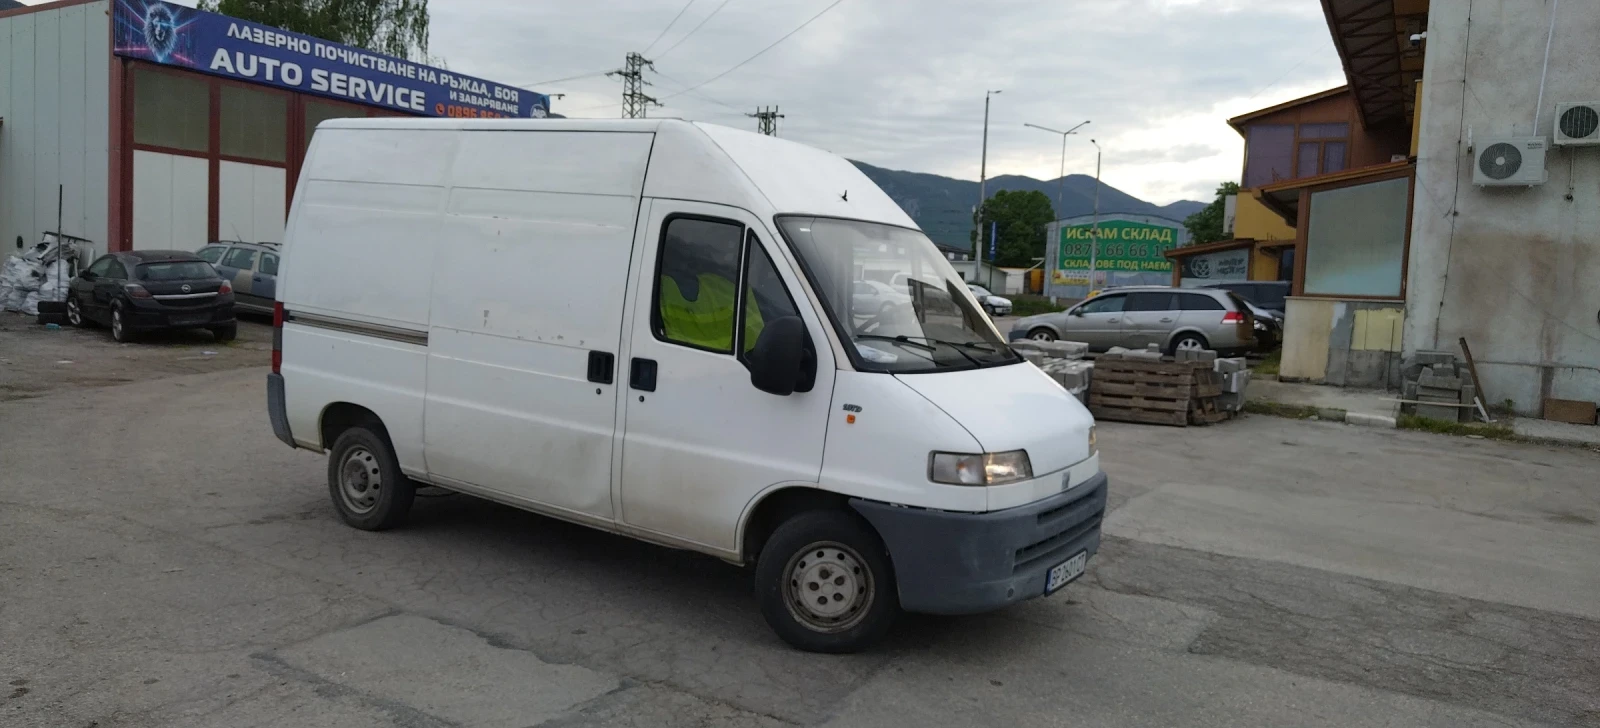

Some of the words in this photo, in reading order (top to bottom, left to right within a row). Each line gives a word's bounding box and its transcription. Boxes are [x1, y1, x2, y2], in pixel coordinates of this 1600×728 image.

[227, 22, 311, 54] ЛАЗЕРНО
[315, 43, 416, 79] ПОЧИСТВАНЕ
[418, 67, 438, 84] НА
[440, 73, 491, 98] РЪЖДА,
[494, 86, 519, 102] БОЯ
[209, 47, 303, 86] AUTO
[310, 68, 426, 112] SERVICE
[449, 90, 457, 100] И
[459, 93, 519, 114] ЗАВАРЯВАНЕ
[1066, 227, 1118, 240] ИСКАМ
[1121, 227, 1172, 243] СКЛАД
[1105, 243, 1124, 257] 66
[1129, 243, 1148, 257] 66
[1117, 260, 1139, 270] ПОД
[1141, 261, 1171, 270] НАЕМ
